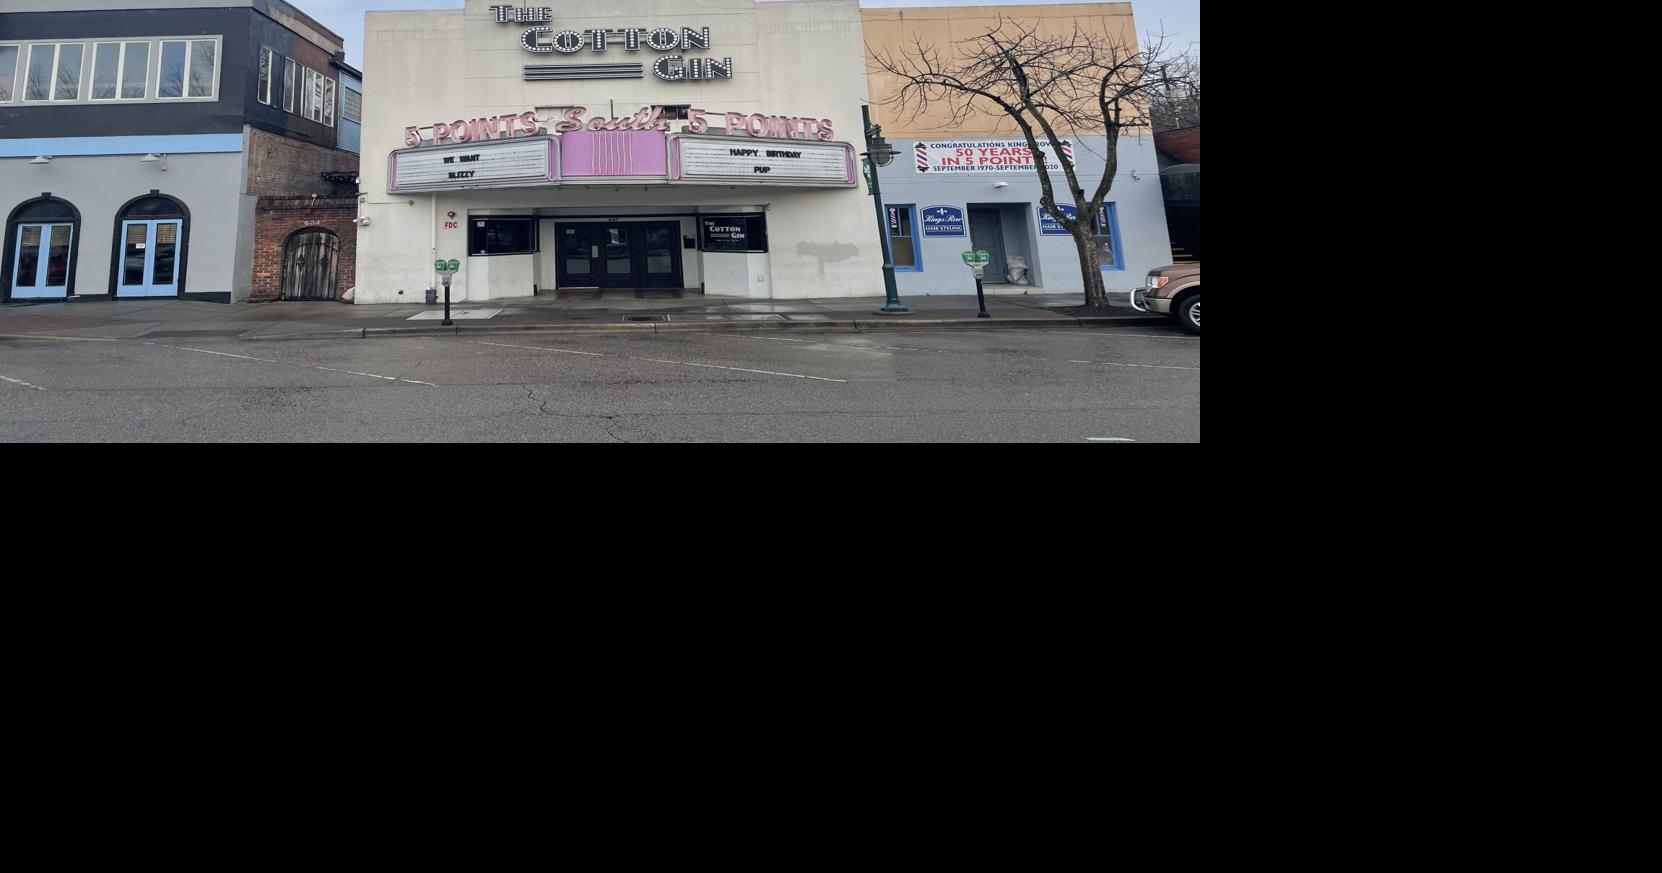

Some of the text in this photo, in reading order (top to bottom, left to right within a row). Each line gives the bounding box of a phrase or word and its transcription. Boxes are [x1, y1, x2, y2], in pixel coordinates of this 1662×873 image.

[489, 5, 552, 23] THE
[520, 25, 711, 53] COTTON
[653, 55, 733, 80] GIN
[555, 105, 670, 132] South
[687, 109, 834, 142] 5 POINTS
[404, 111, 539, 147] 5 POINTS
[460, 154, 480, 163] WANT
[729, 149, 802, 159] HAPPY BIRTHDAY
[956, 148, 1032, 157] 50 YEARS
[942, 156, 1048, 165] IN 5 POINT!
[753, 166, 771, 174] PUP
[925, 215, 944, 224] Kings
